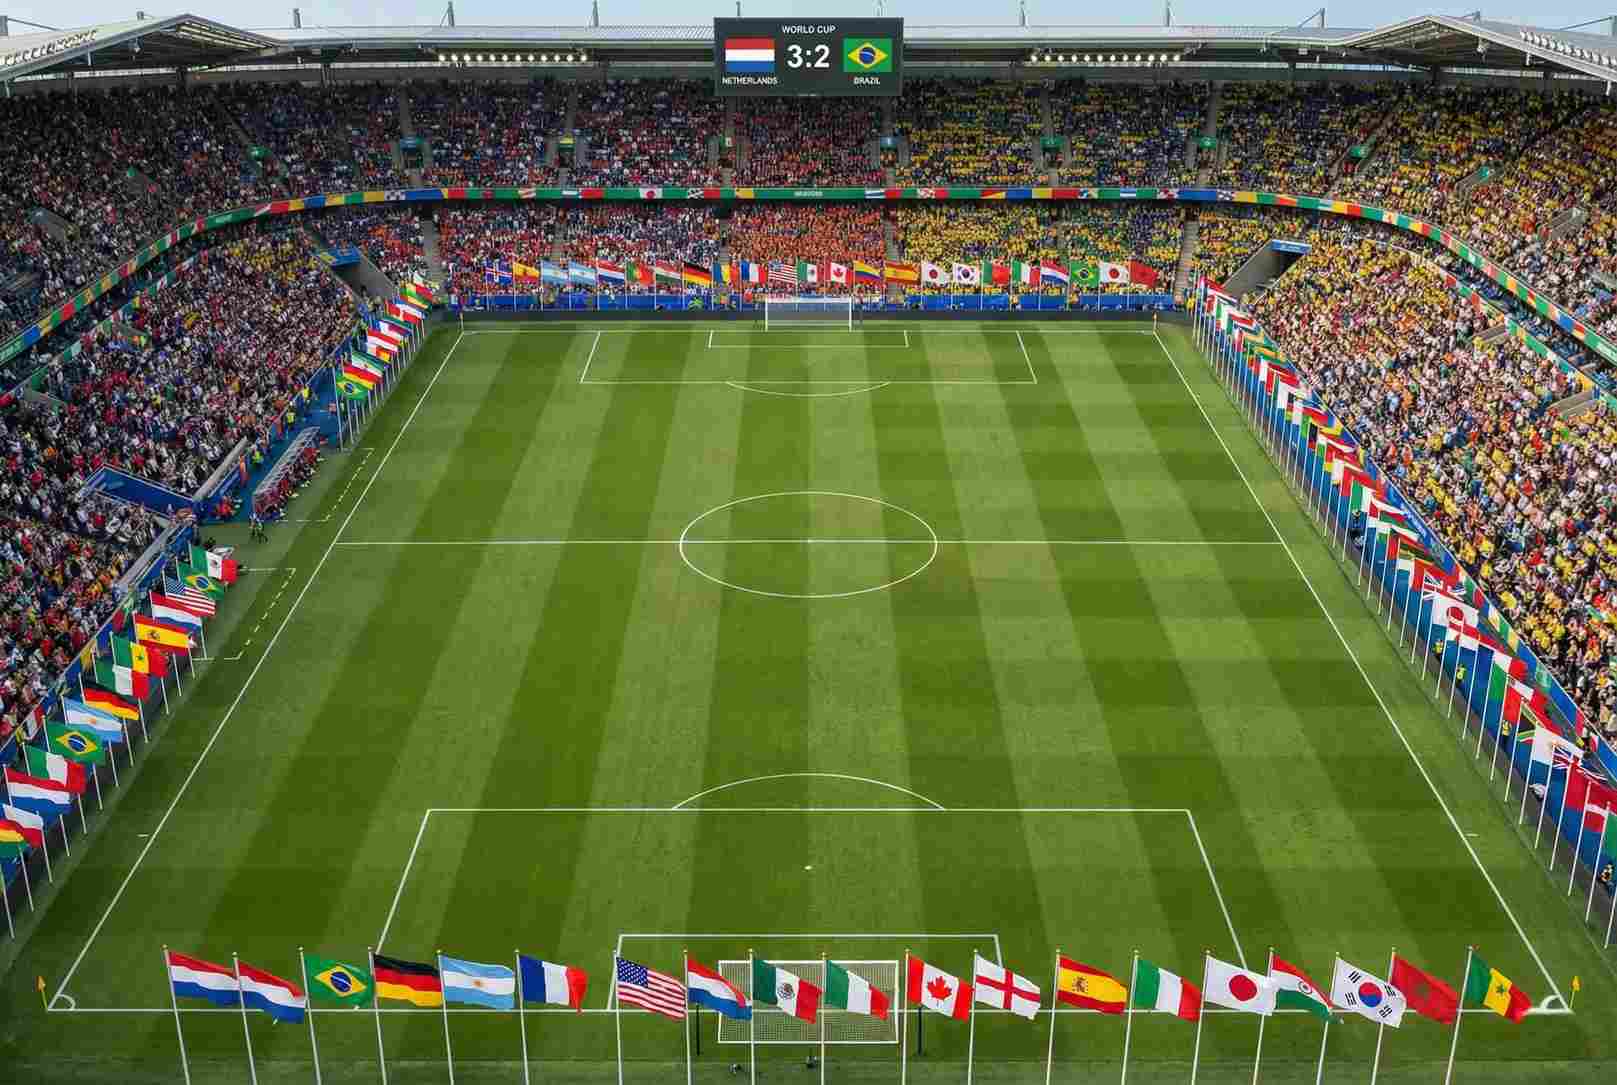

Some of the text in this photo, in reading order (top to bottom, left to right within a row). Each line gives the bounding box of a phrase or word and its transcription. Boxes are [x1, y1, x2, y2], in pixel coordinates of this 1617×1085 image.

[782, 25, 836, 34] WORLD CUP
[786, 44, 830, 68] 3:2
[722, 76, 778, 85] NETHERLANDS
[853, 76, 881, 85] BRAZIL
